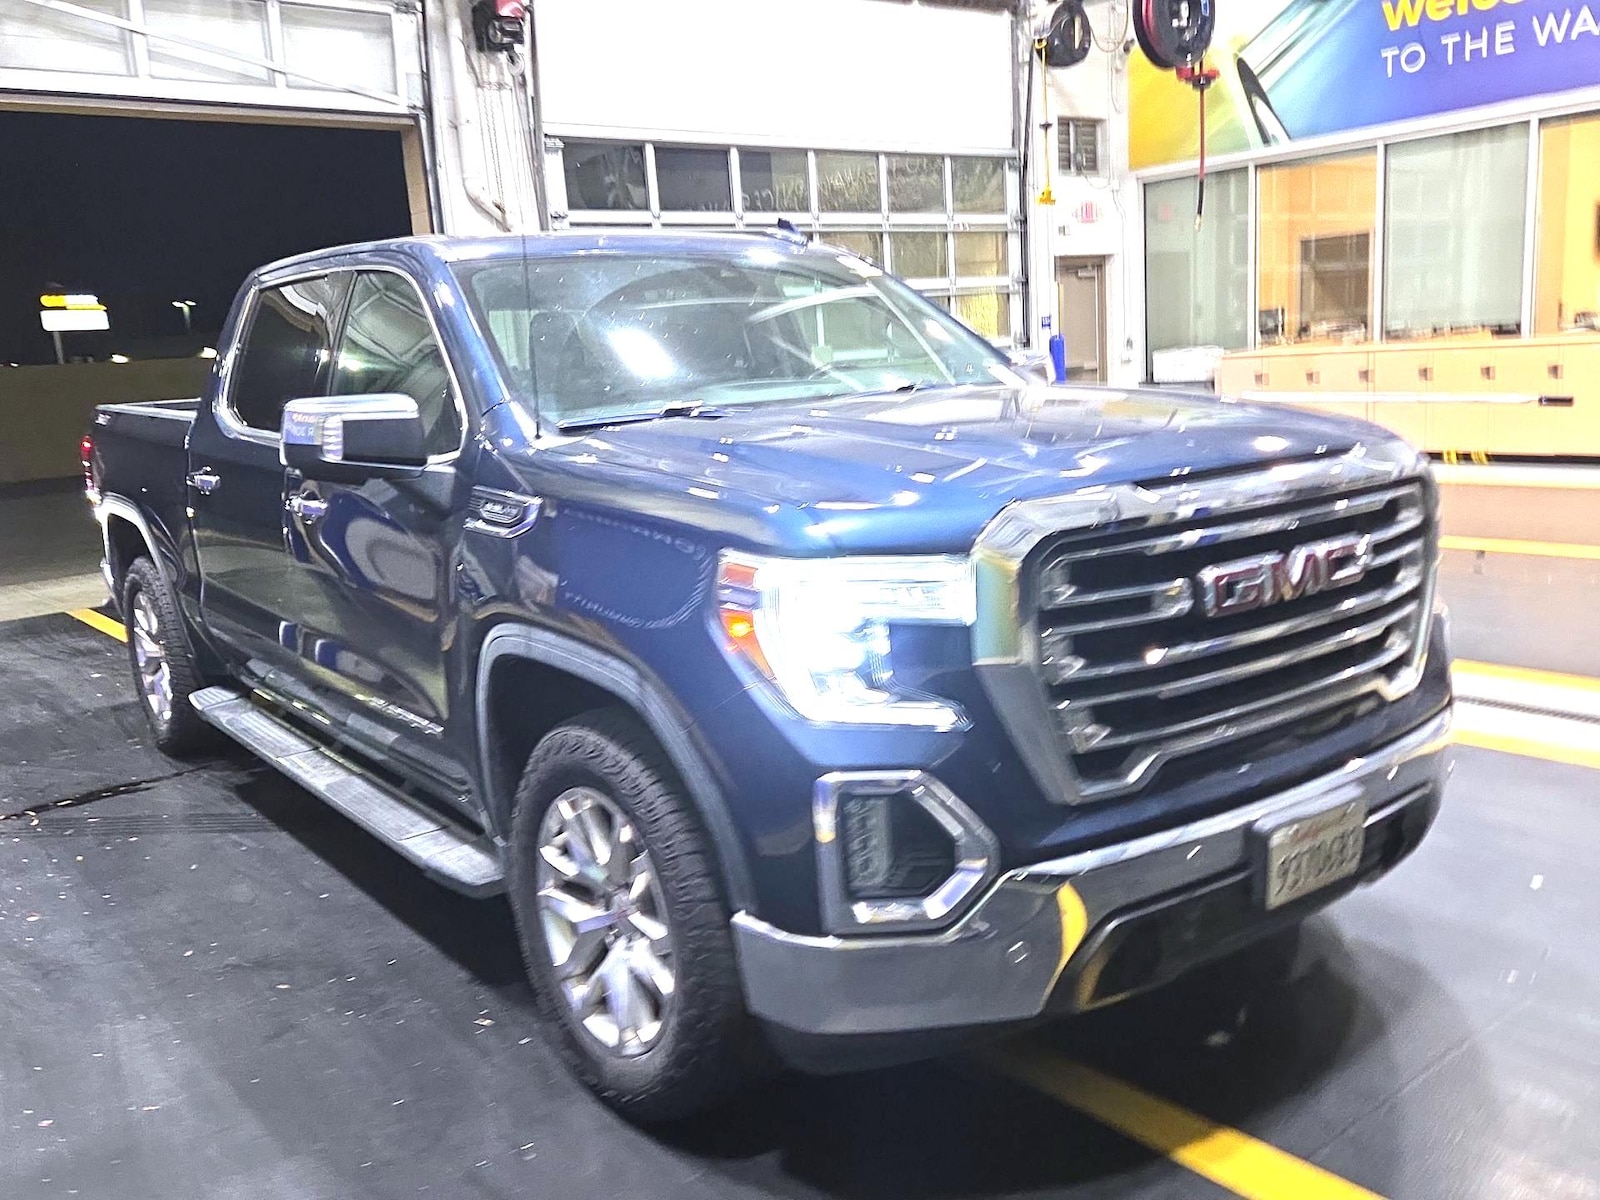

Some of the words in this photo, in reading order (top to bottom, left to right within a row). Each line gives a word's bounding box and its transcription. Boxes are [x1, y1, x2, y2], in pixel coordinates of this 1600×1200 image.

[1380, 42, 1426, 78] TO
[1440, 20, 1516, 66] THE
[1531, 4, 1600, 47] WA
[1198, 532, 1371, 617] GMC
